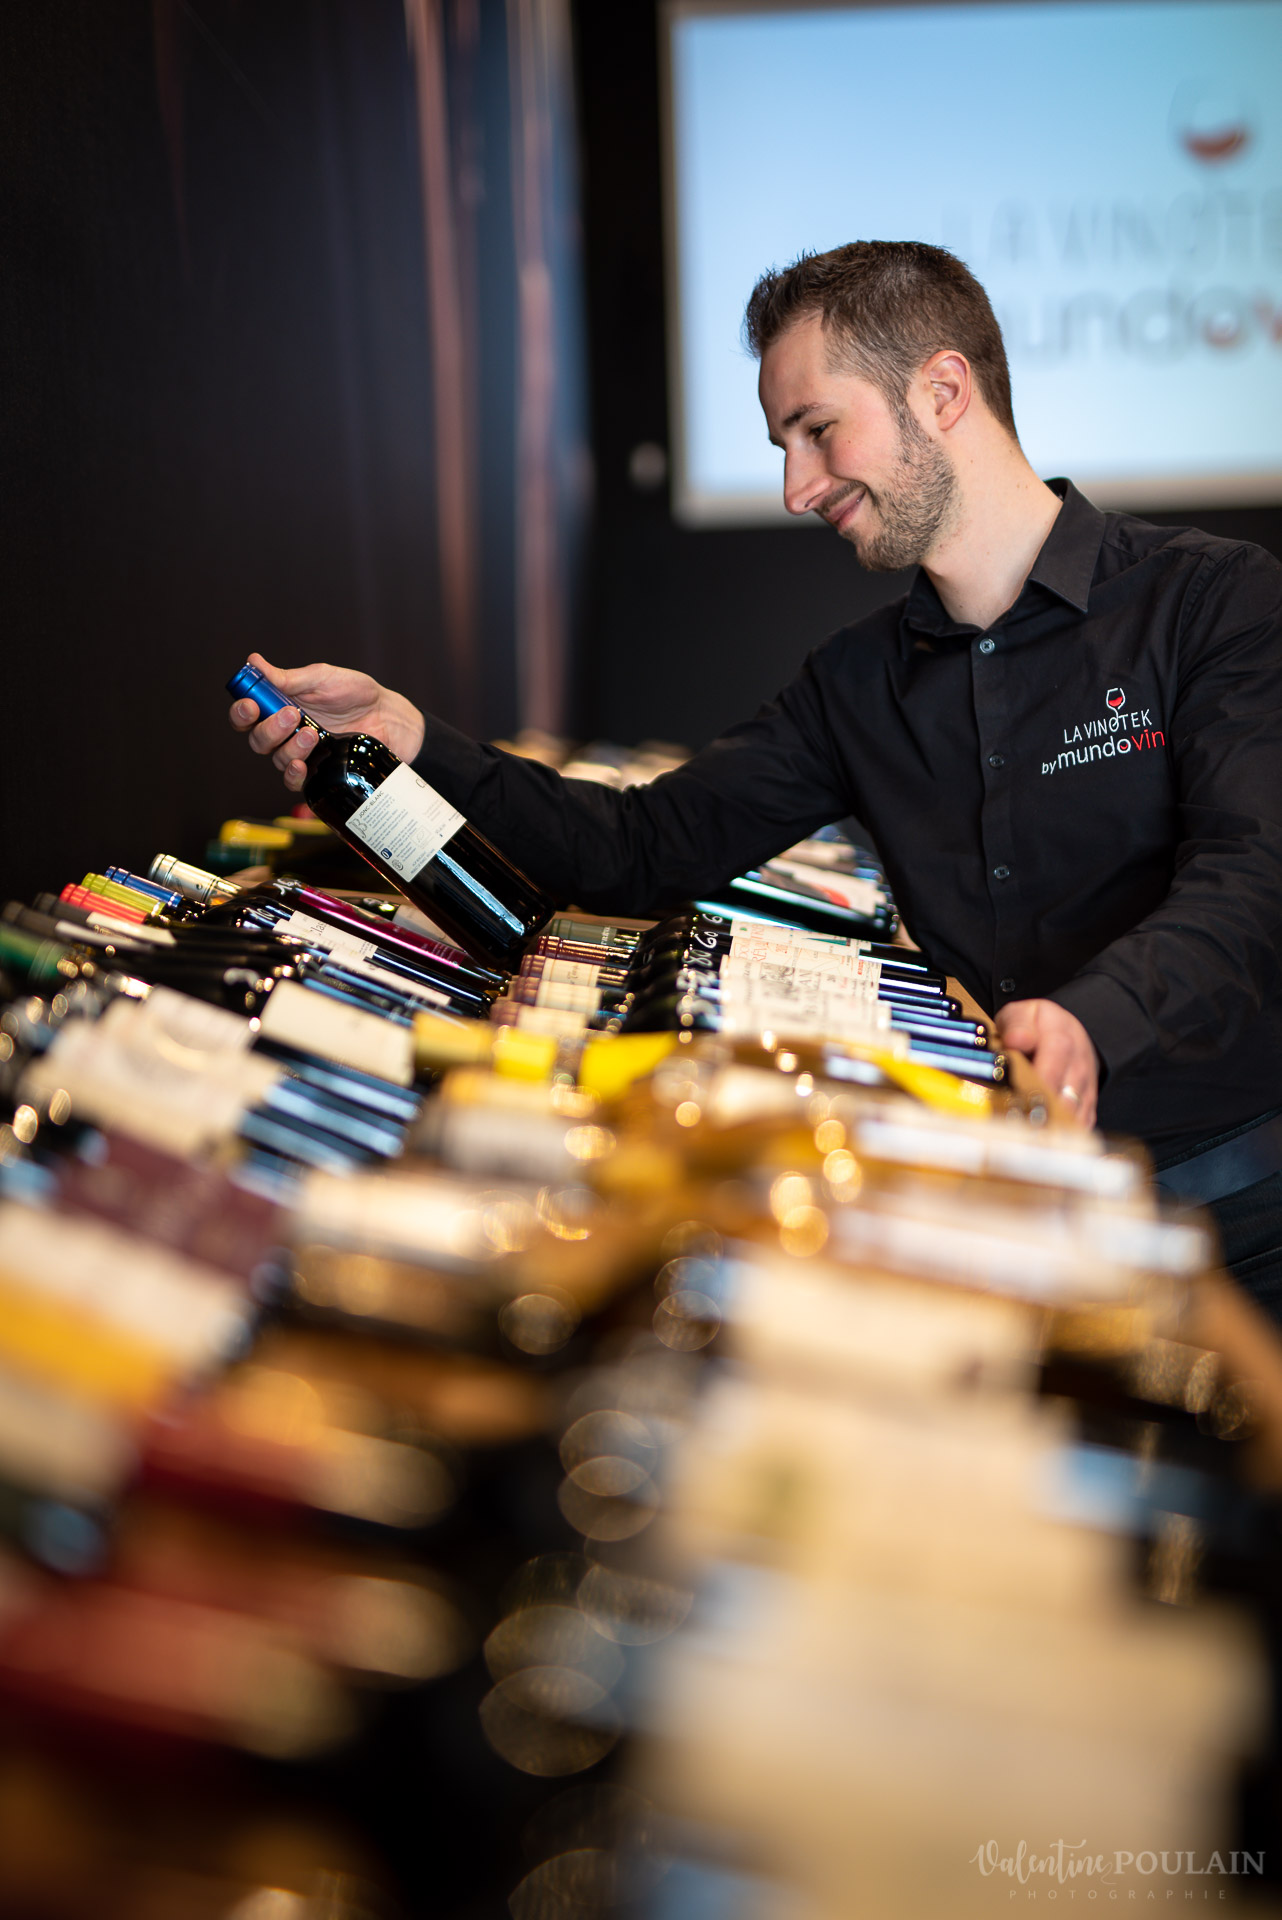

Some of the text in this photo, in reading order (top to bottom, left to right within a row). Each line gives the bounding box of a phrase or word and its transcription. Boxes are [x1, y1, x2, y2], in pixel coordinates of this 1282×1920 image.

[1063, 709, 1153, 744] LA VINOTEK
[1041, 729, 1166, 775] by mundovin
[694, 931, 720, 949] 60
